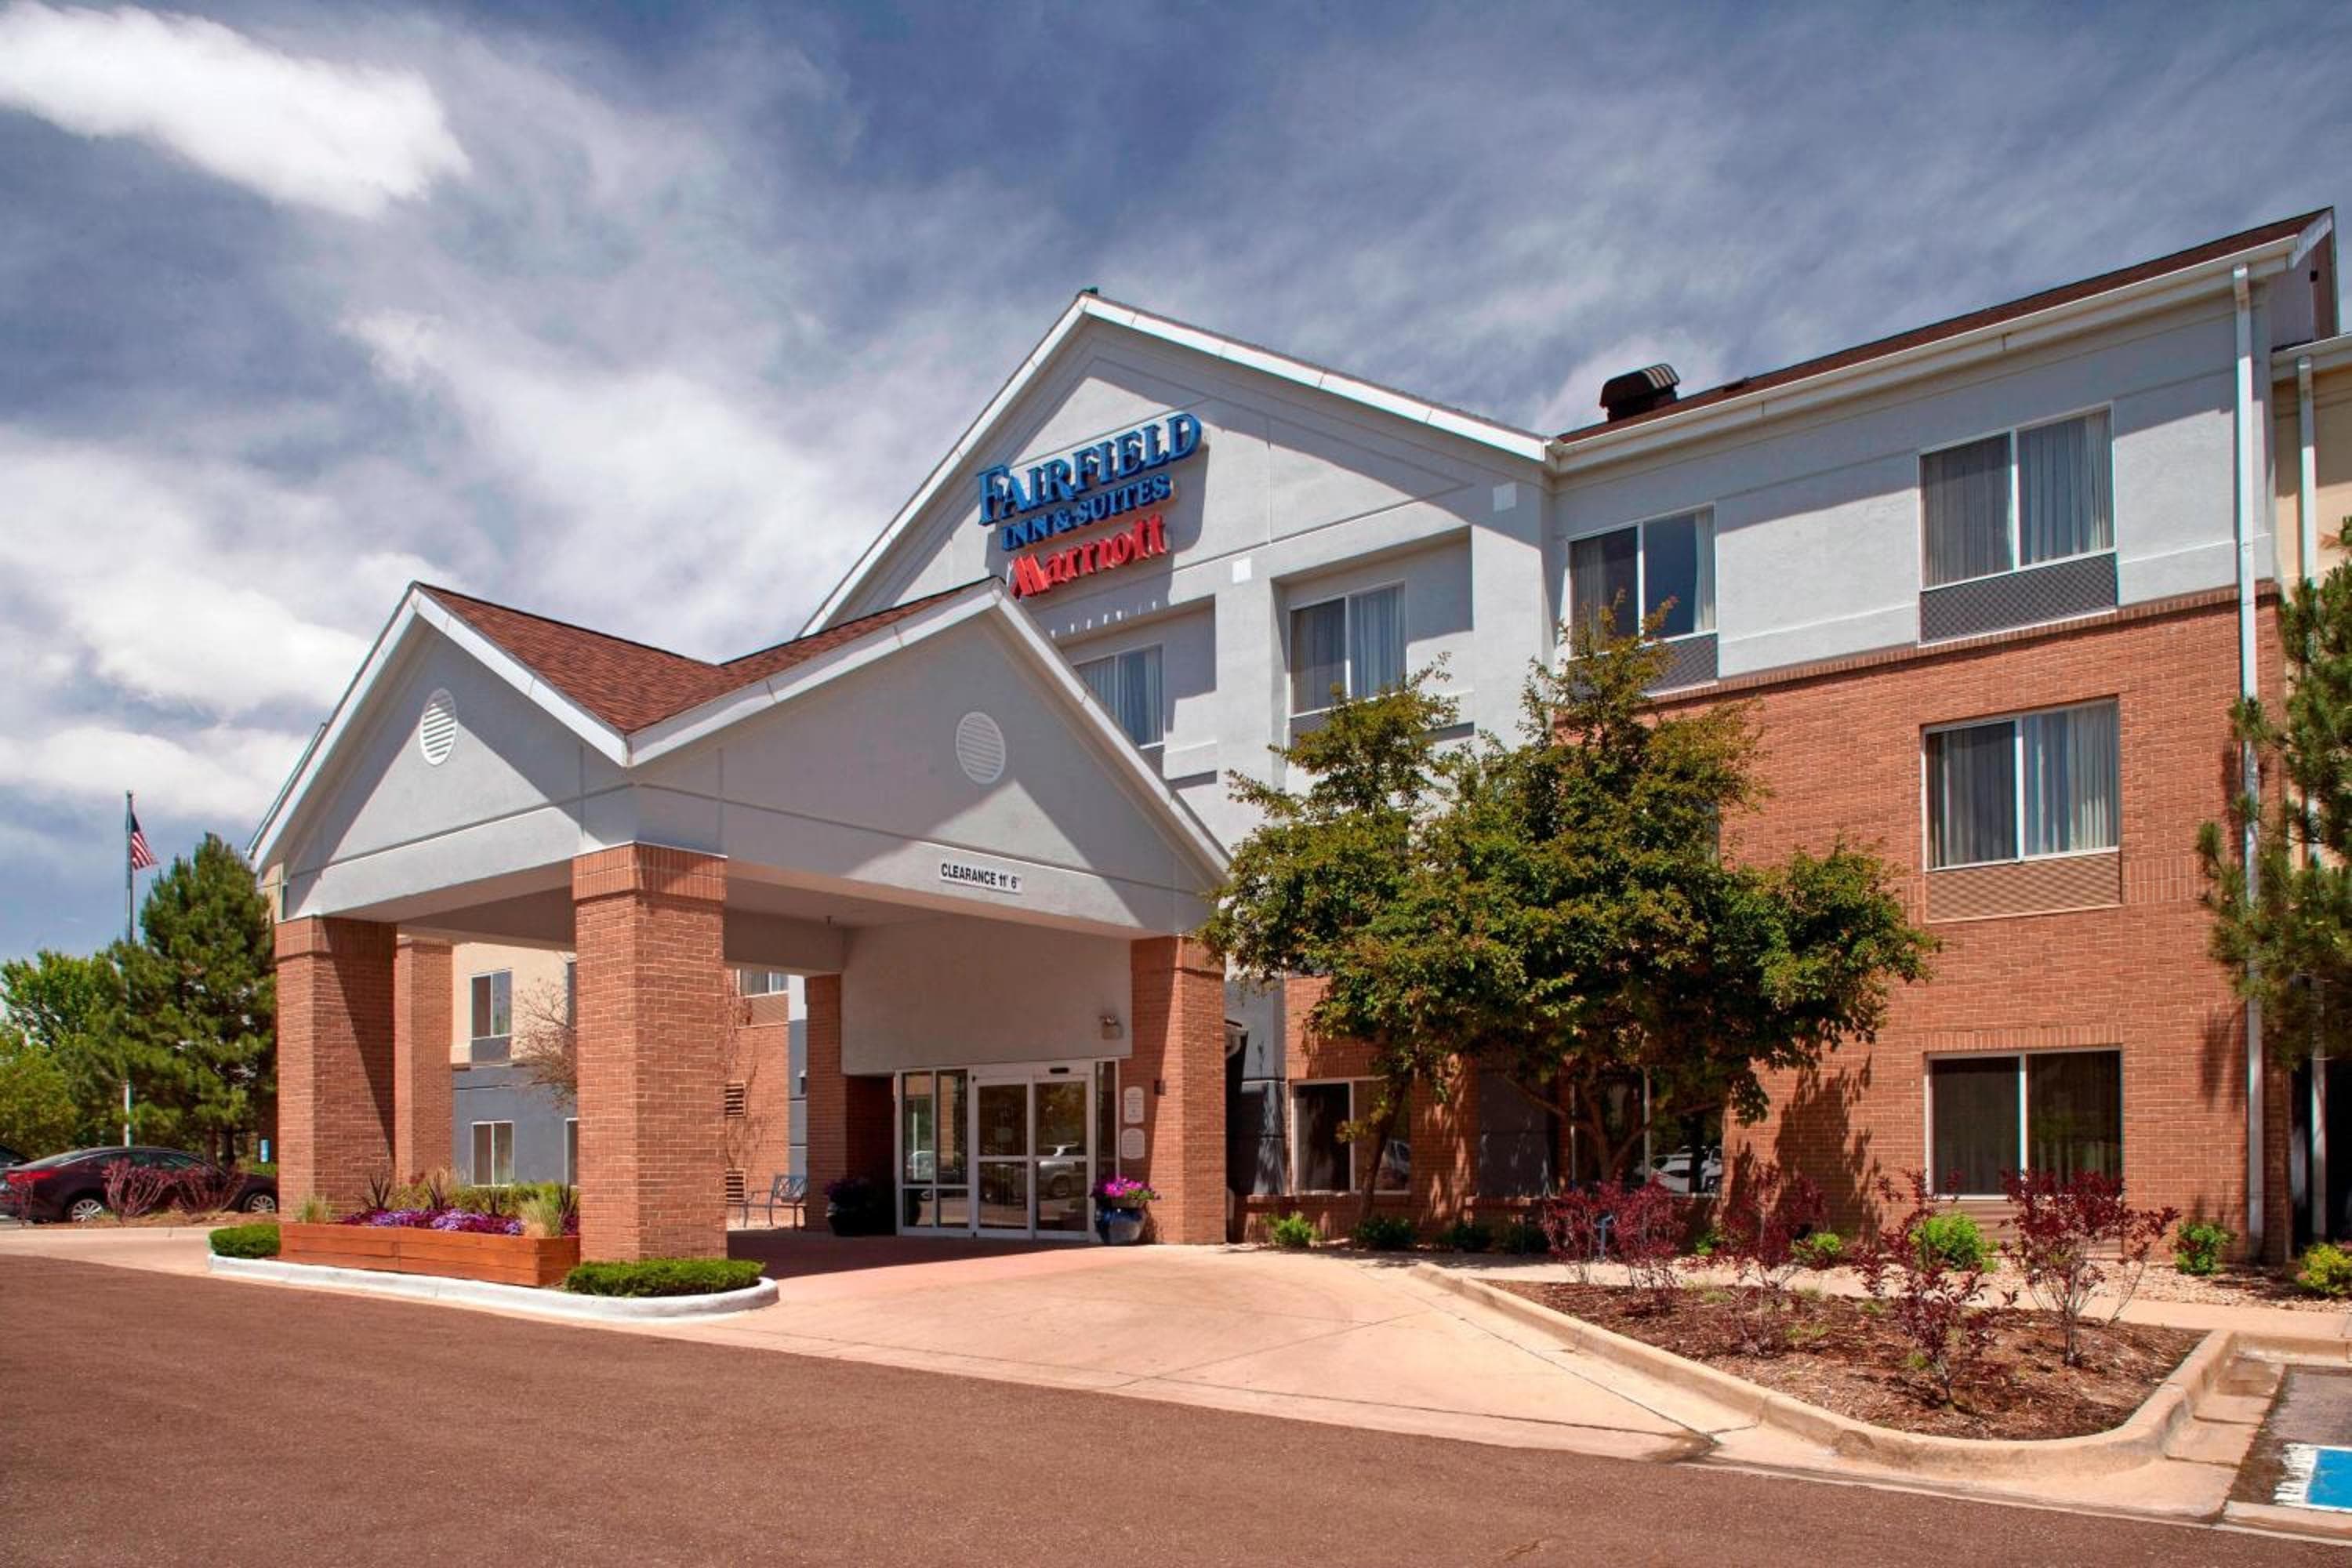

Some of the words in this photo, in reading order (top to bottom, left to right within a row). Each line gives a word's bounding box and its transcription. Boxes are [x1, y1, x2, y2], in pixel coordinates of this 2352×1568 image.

[978, 412, 1203, 526] FAIRFIELD
[1011, 514, 1167, 599] Marriott
[941, 862, 996, 885] CLEARANCE
